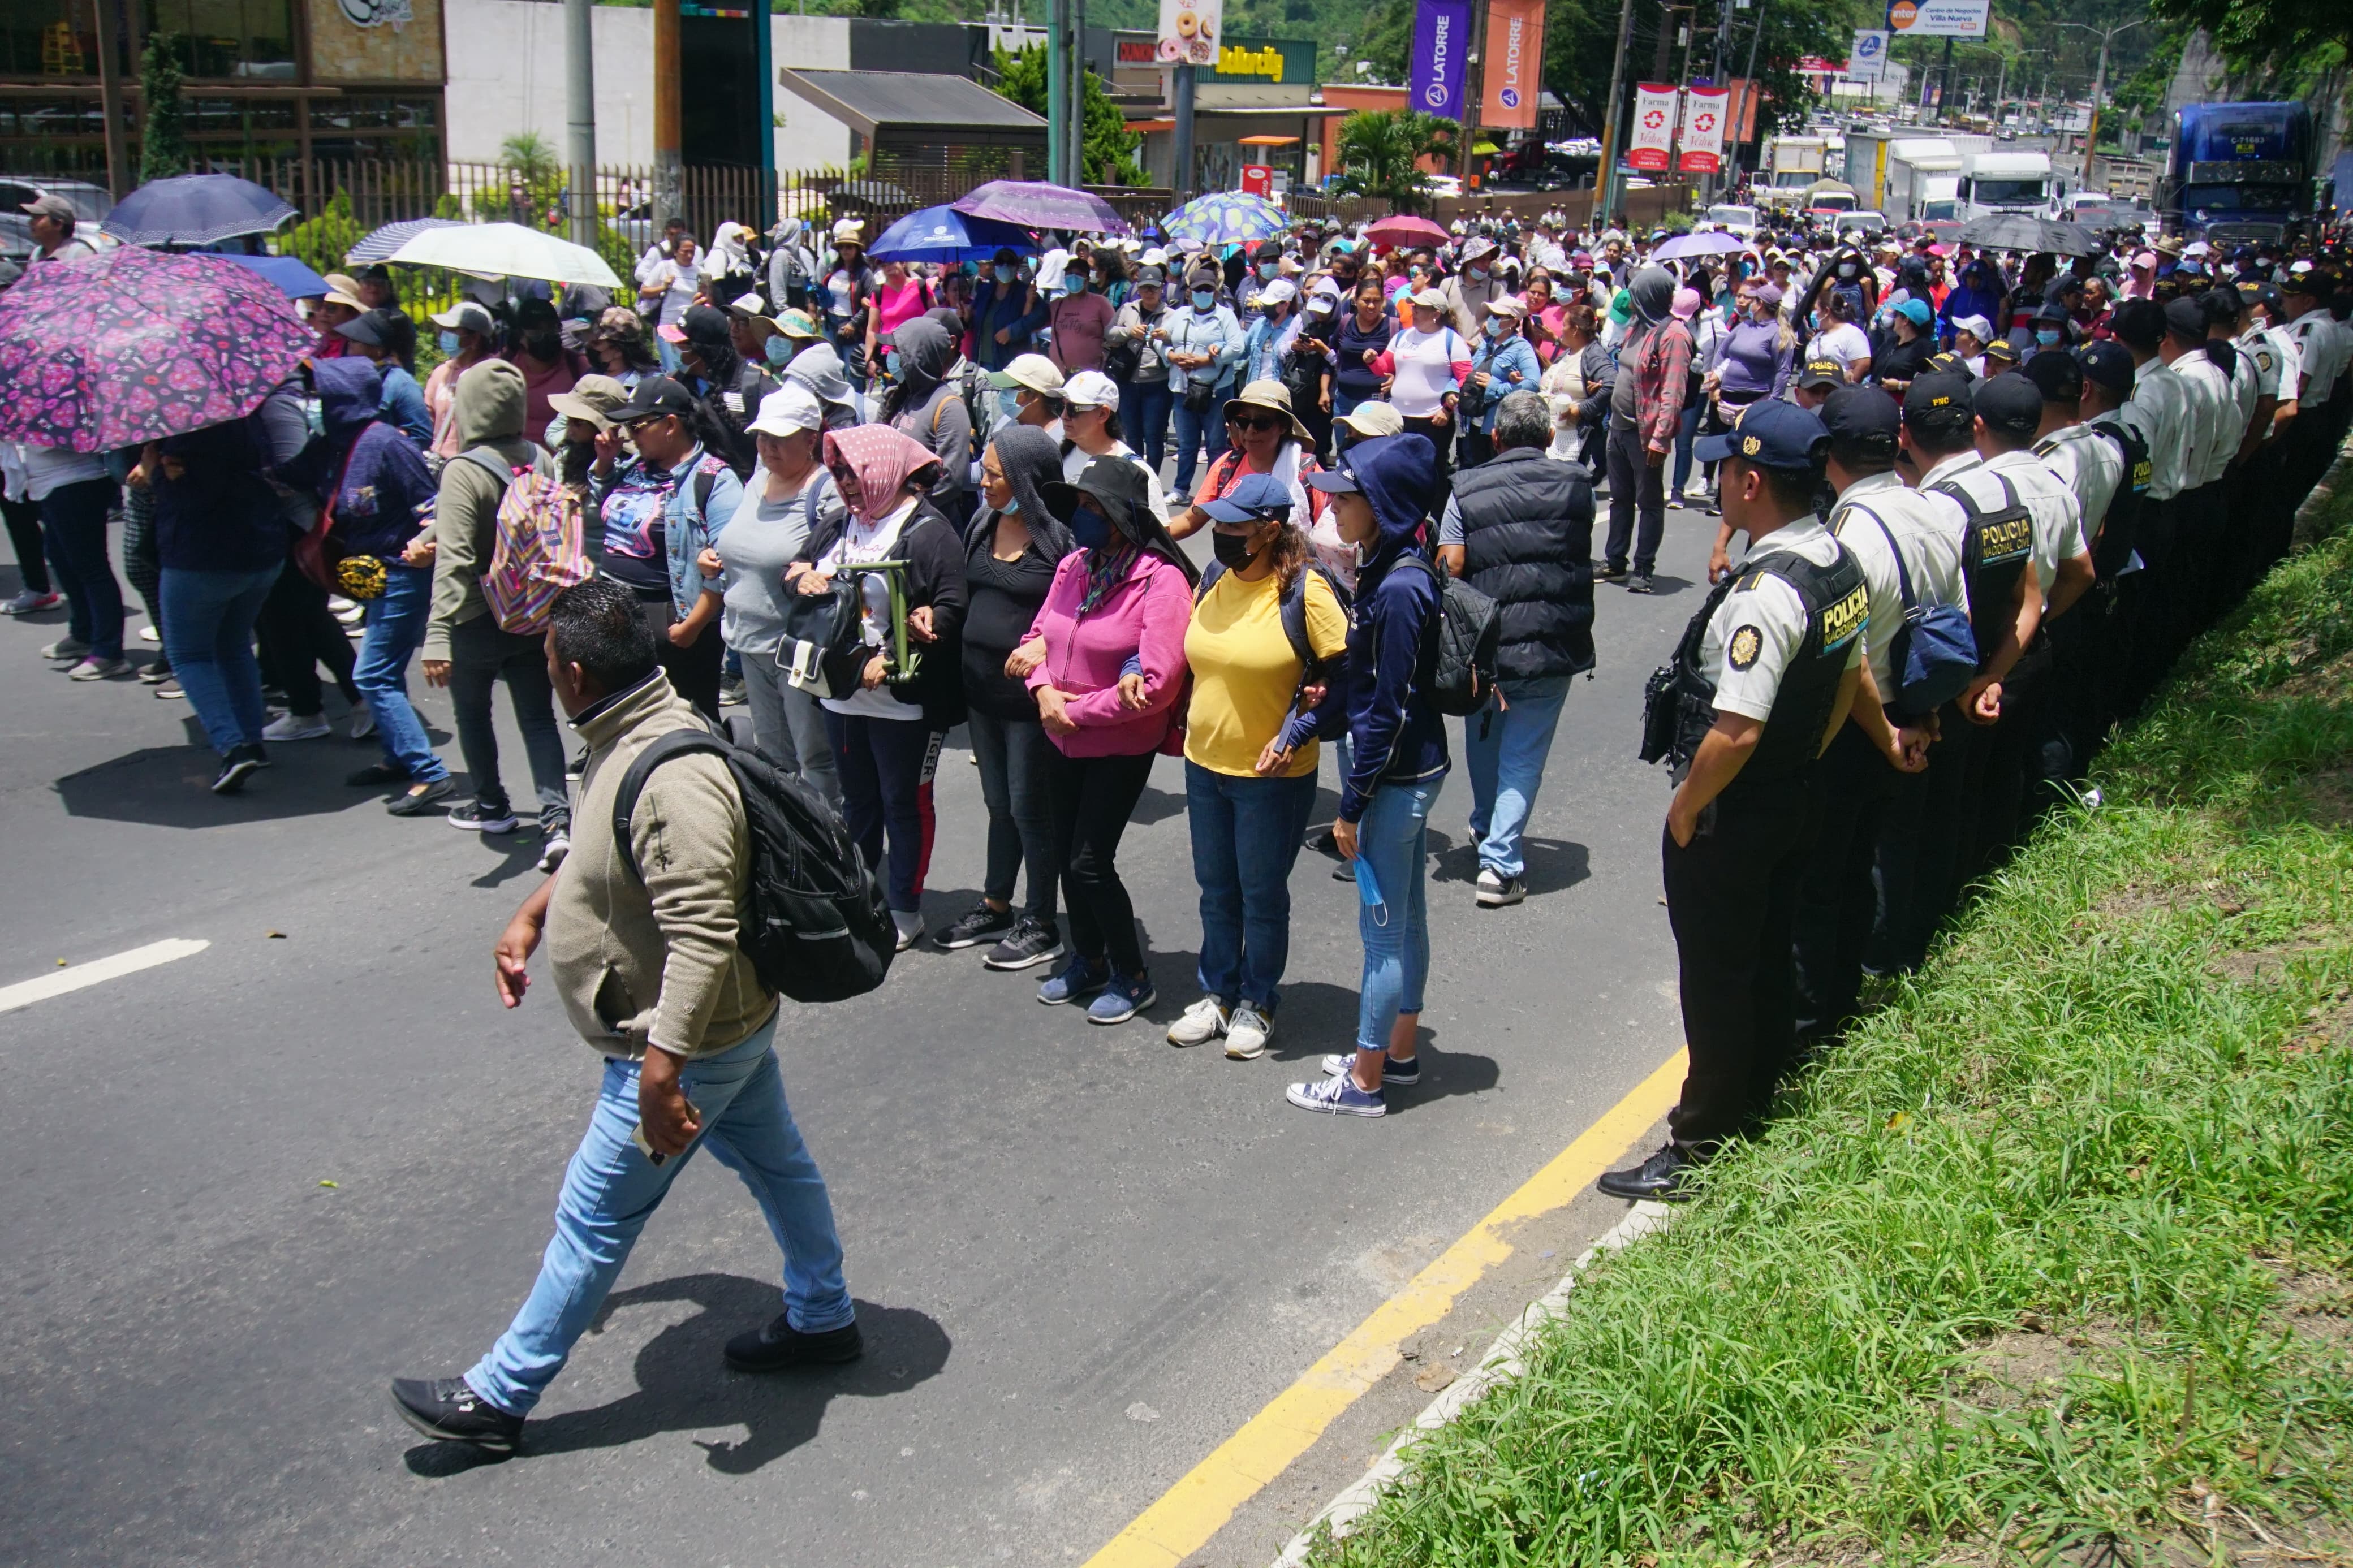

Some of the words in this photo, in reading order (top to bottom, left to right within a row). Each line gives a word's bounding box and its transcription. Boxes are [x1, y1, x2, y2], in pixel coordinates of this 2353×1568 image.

[1892, 8, 1915, 18] inter
[1432, 15, 1449, 82] LATORRE
[1506, 17, 1522, 84] LATORRE
[1643, 97, 1669, 106] Farma
[1693, 100, 1720, 109] Farma
[1809, 362, 1839, 372] POLICIA
[1933, 396, 1949, 407] PNC
[1981, 519, 2030, 547] POLICIA
[1983, 543, 2014, 558] NACIONAL
[2016, 537, 2031, 550] CIVIL
[1824, 584, 1869, 633] POLICIA
[1824, 617, 1858, 646] NACIONAL
[923, 737, 941, 776] IGER
